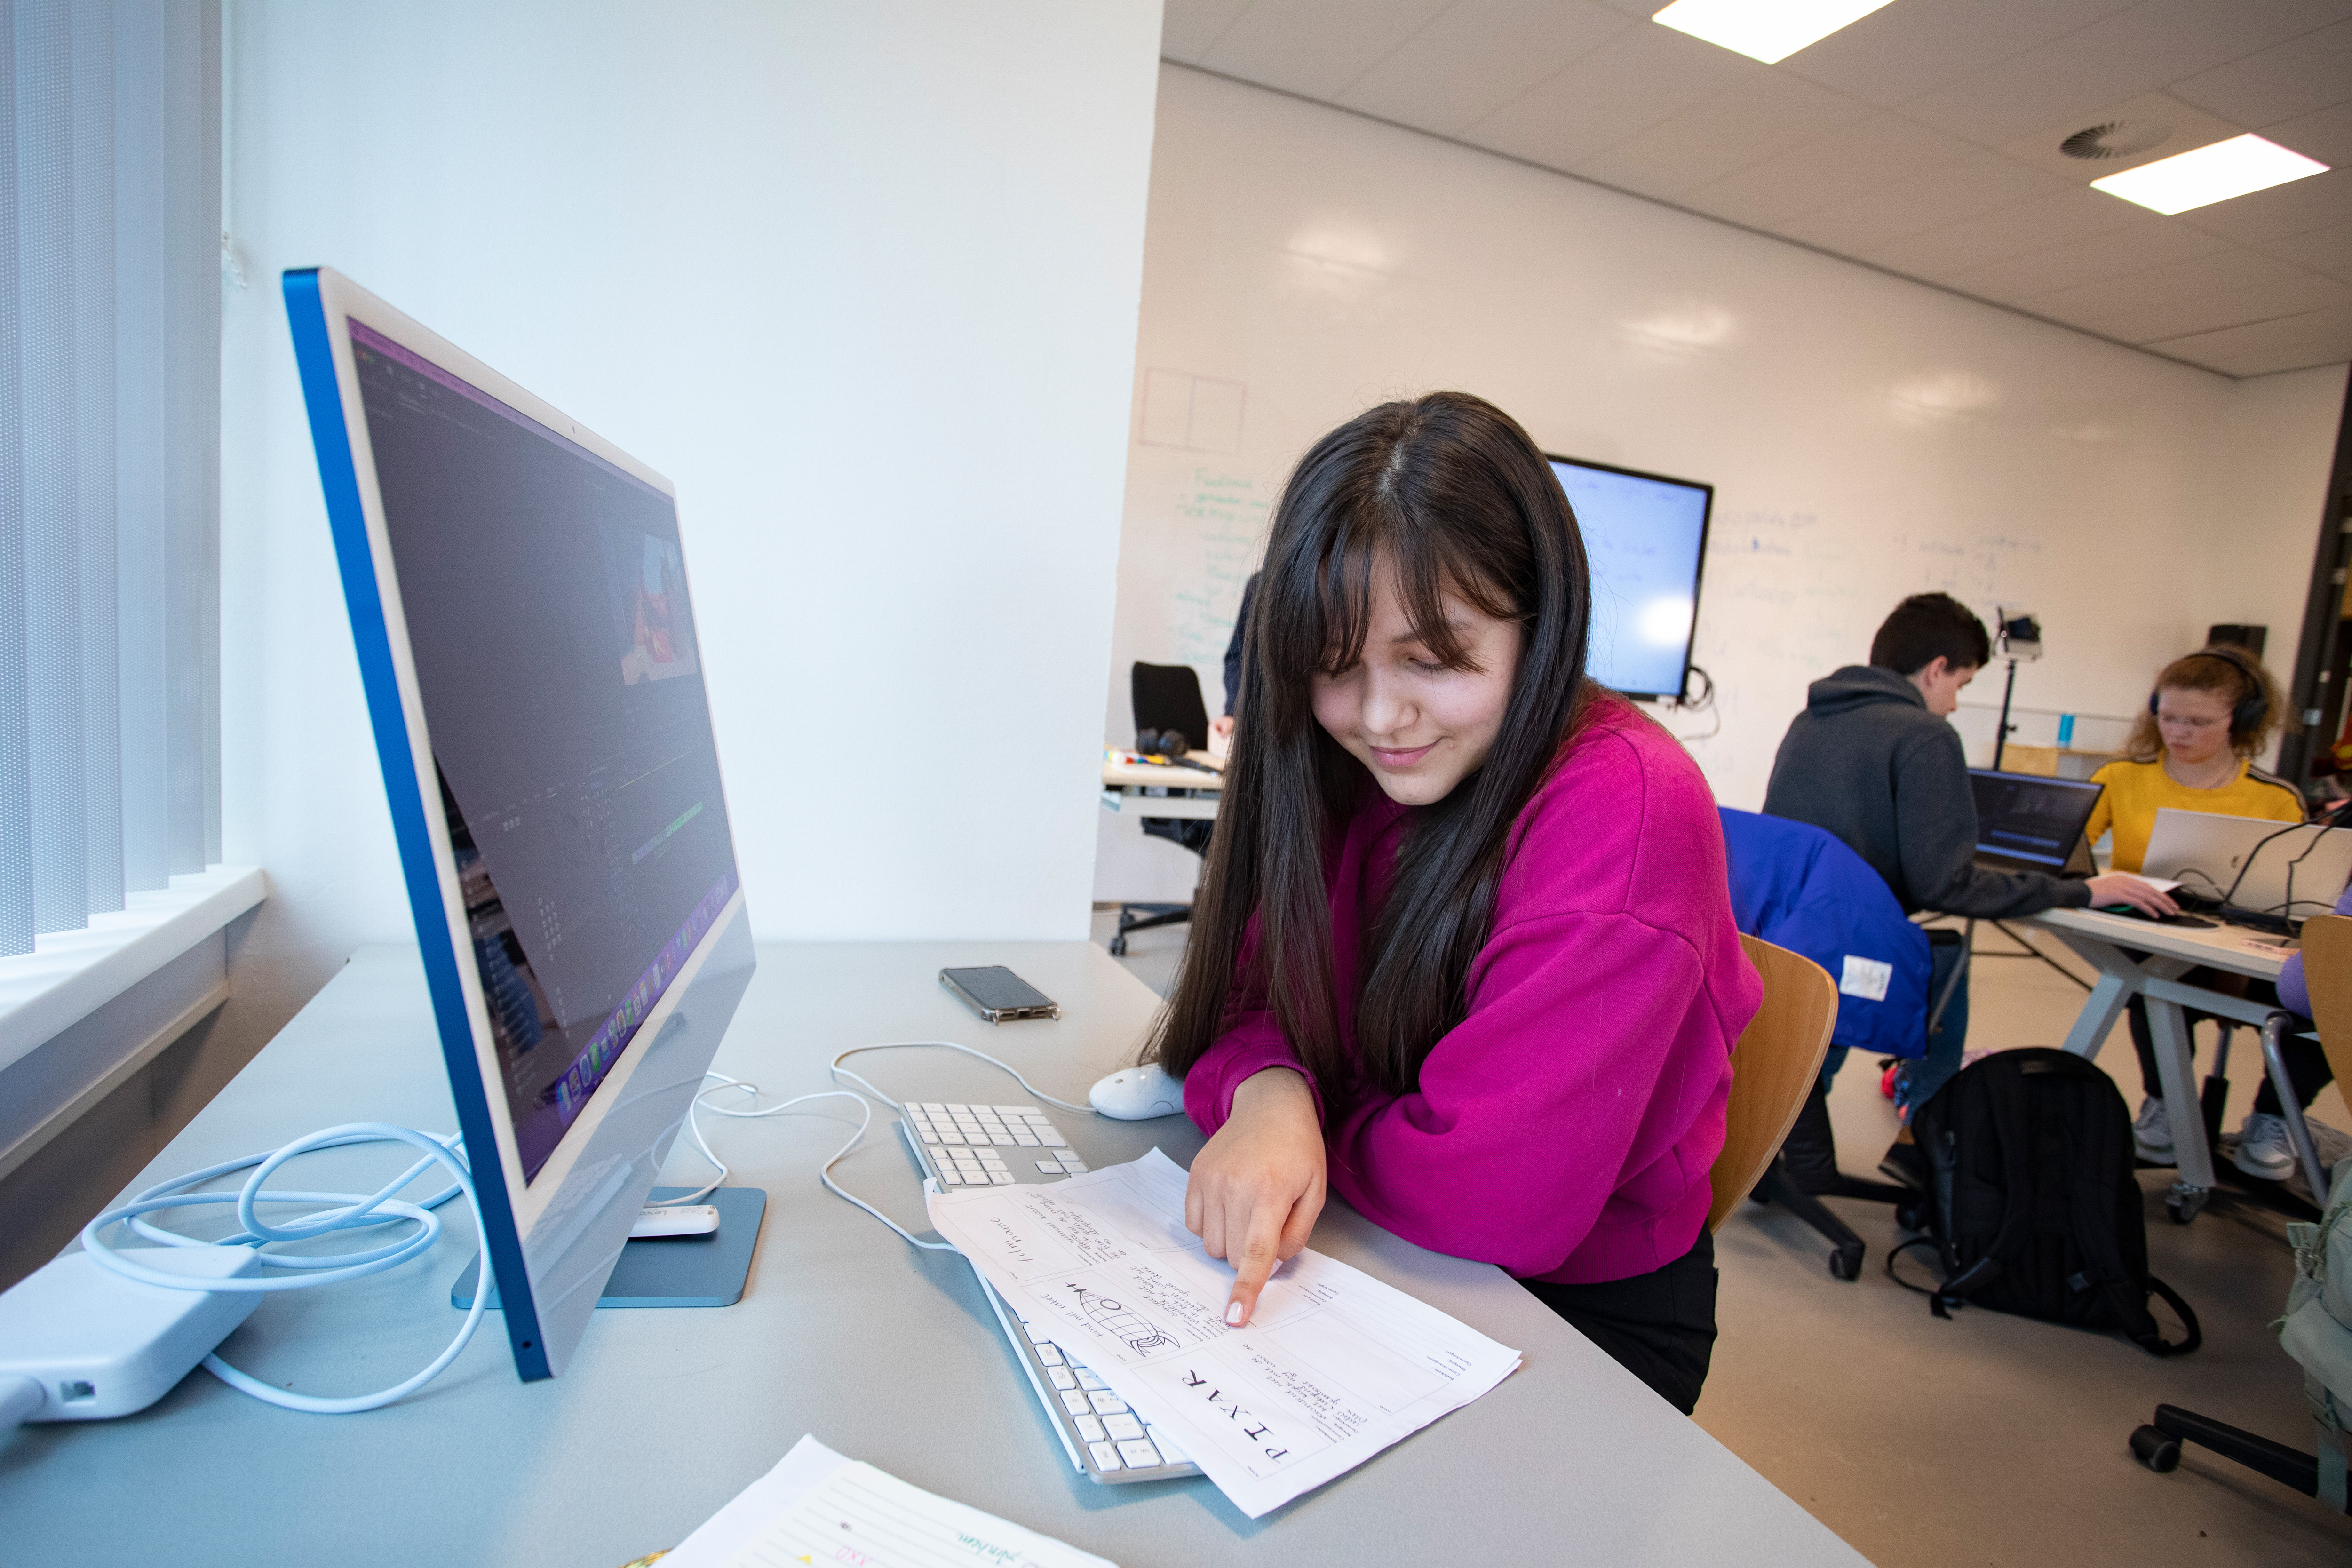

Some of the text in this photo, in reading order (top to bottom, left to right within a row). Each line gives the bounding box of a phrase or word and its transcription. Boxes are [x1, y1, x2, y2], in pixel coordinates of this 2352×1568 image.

[991, 1217, 1021, 1242] name
[1046, 1222, 1075, 1244] helemaal
[1070, 1234, 1090, 1250] effects
[1095, 1239, 1110, 1250] film
[1005, 1241, 1033, 1263] film
[1133, 1276, 1154, 1289] beeld
[1147, 1277, 1166, 1289] want
[1166, 1283, 1190, 1296] goede
[1138, 1286, 1155, 1294] niet
[1042, 1294, 1065, 1309] raket
[1171, 1301, 1186, 1309] heb
[1446, 1351, 1471, 1366] Opmerkingen:
[1427, 1356, 1460, 1376] Camerastandpunt:
[1266, 1376, 1282, 1386] niet
[1433, 1369, 1454, 1380] Beeldkader:
[1182, 1369, 1291, 1464] PIXAR
